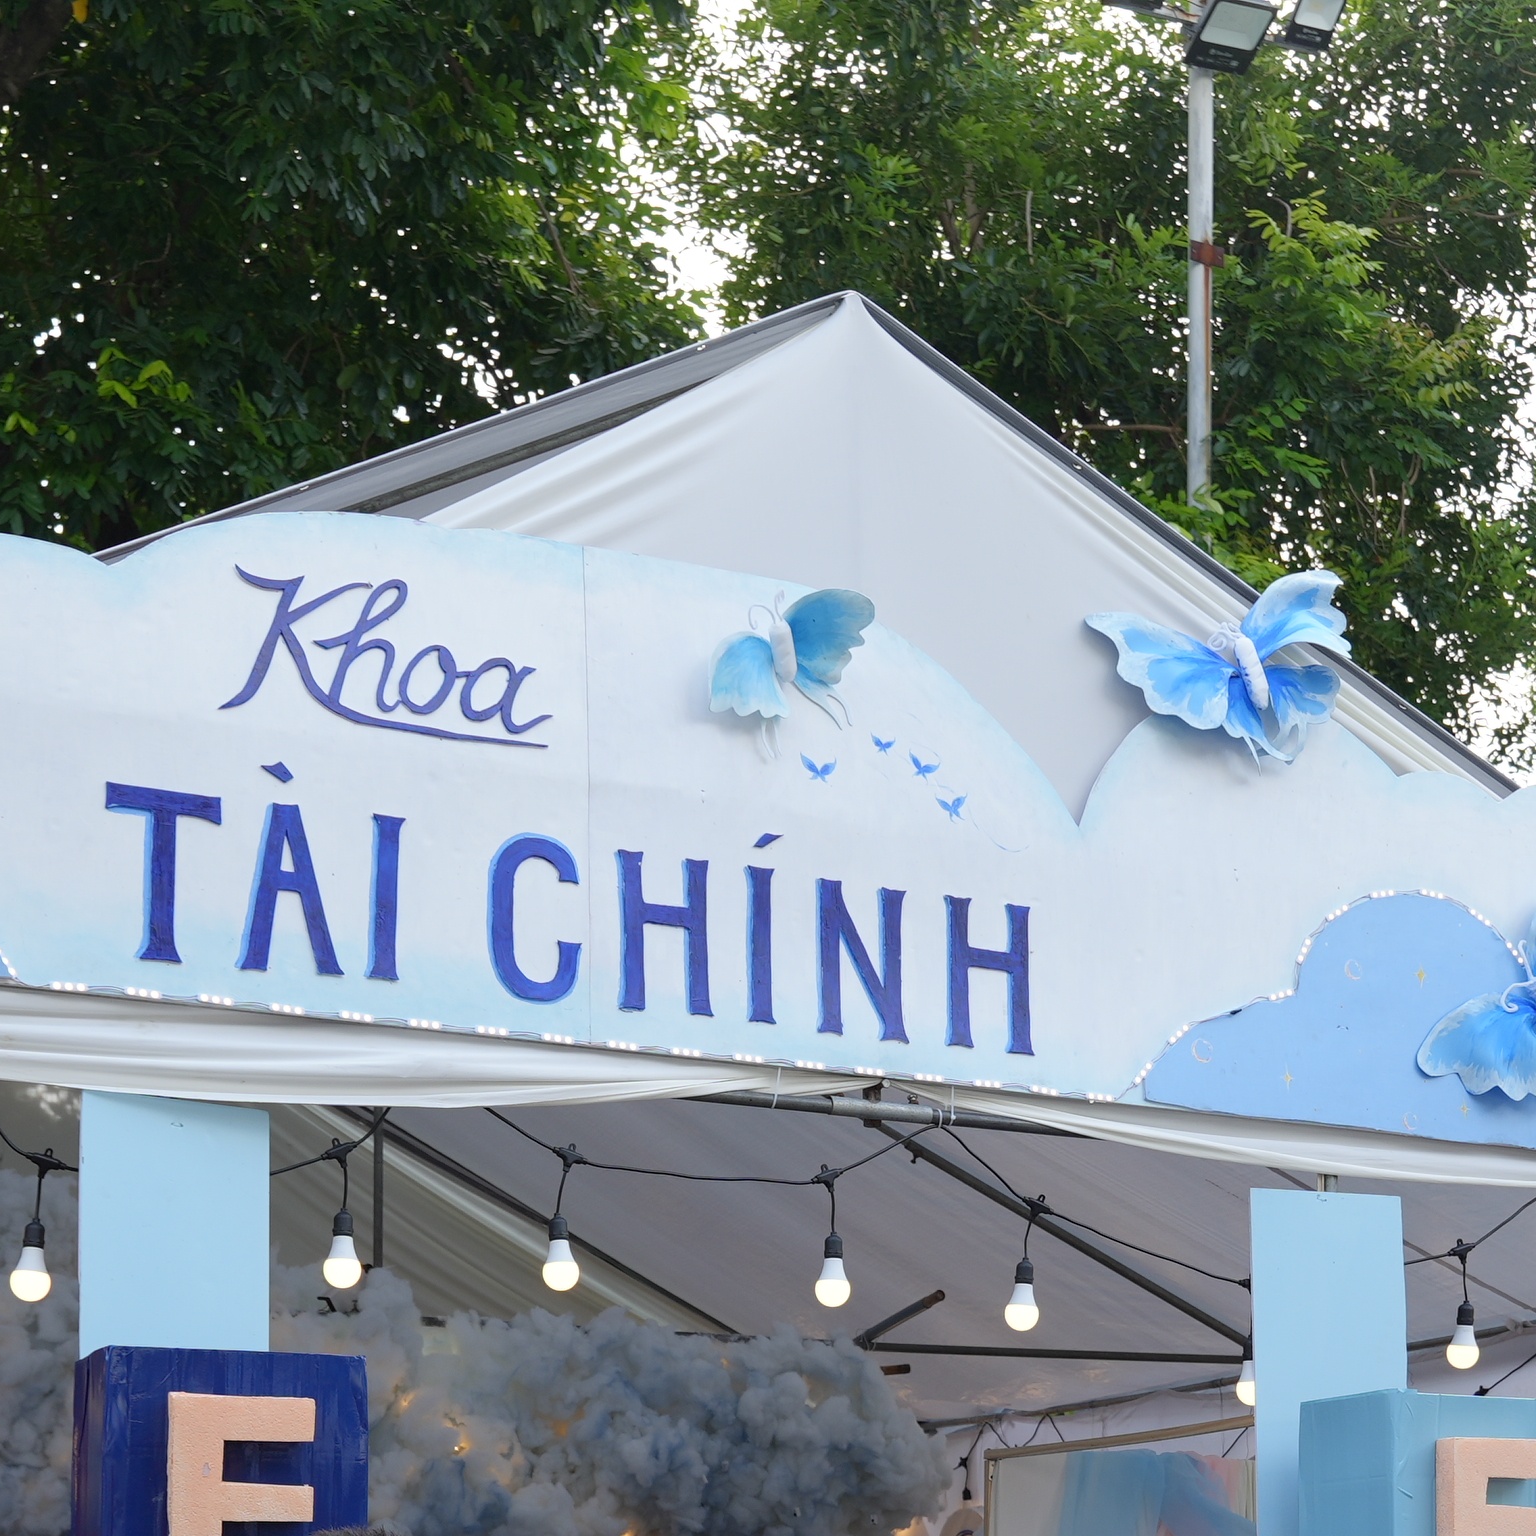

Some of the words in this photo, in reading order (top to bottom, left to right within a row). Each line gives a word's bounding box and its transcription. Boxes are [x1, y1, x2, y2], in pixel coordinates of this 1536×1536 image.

[219, 563, 552, 748] Khoa
[105, 762, 406, 980] TÀI
[487, 832, 1034, 1056] CHÍNH
